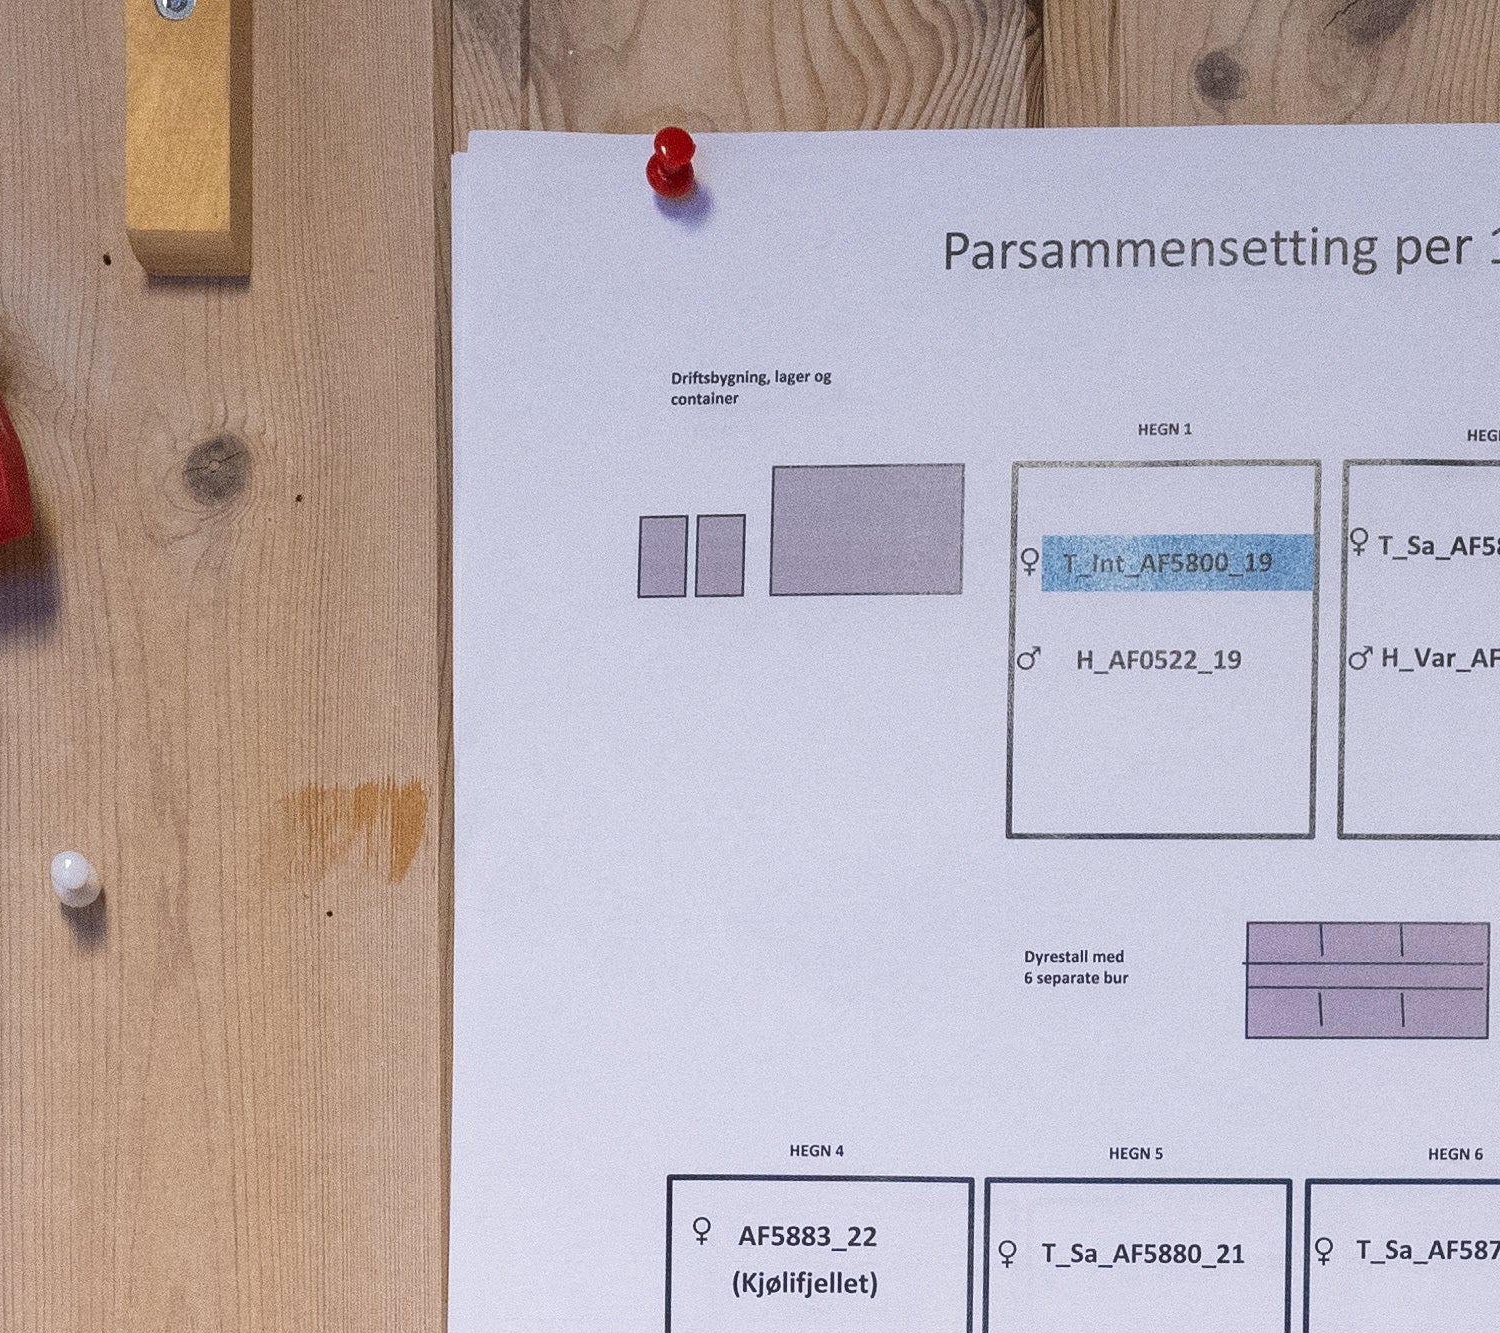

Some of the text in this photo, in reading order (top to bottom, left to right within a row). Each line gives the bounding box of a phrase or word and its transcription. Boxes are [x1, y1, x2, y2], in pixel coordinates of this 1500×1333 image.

[945, 226, 1379, 276] Parsammensetting
[1396, 235, 1473, 275] per
[671, 369, 832, 388] Driftsbygning, lager og
[670, 391, 739, 406] container
[1138, 422, 1192, 436] HEGN 1
[1077, 649, 1242, 675] H_AF0522_19
[1024, 949, 1125, 967] Dyrestall med
[789, 1144, 845, 1158] HEGN 4
[738, 1225, 877, 1252] AF5883_22
[1041, 1242, 1245, 1269] T_Sa_AF5880_21
[732, 1270, 878, 1299] (Kjølifjellet)
